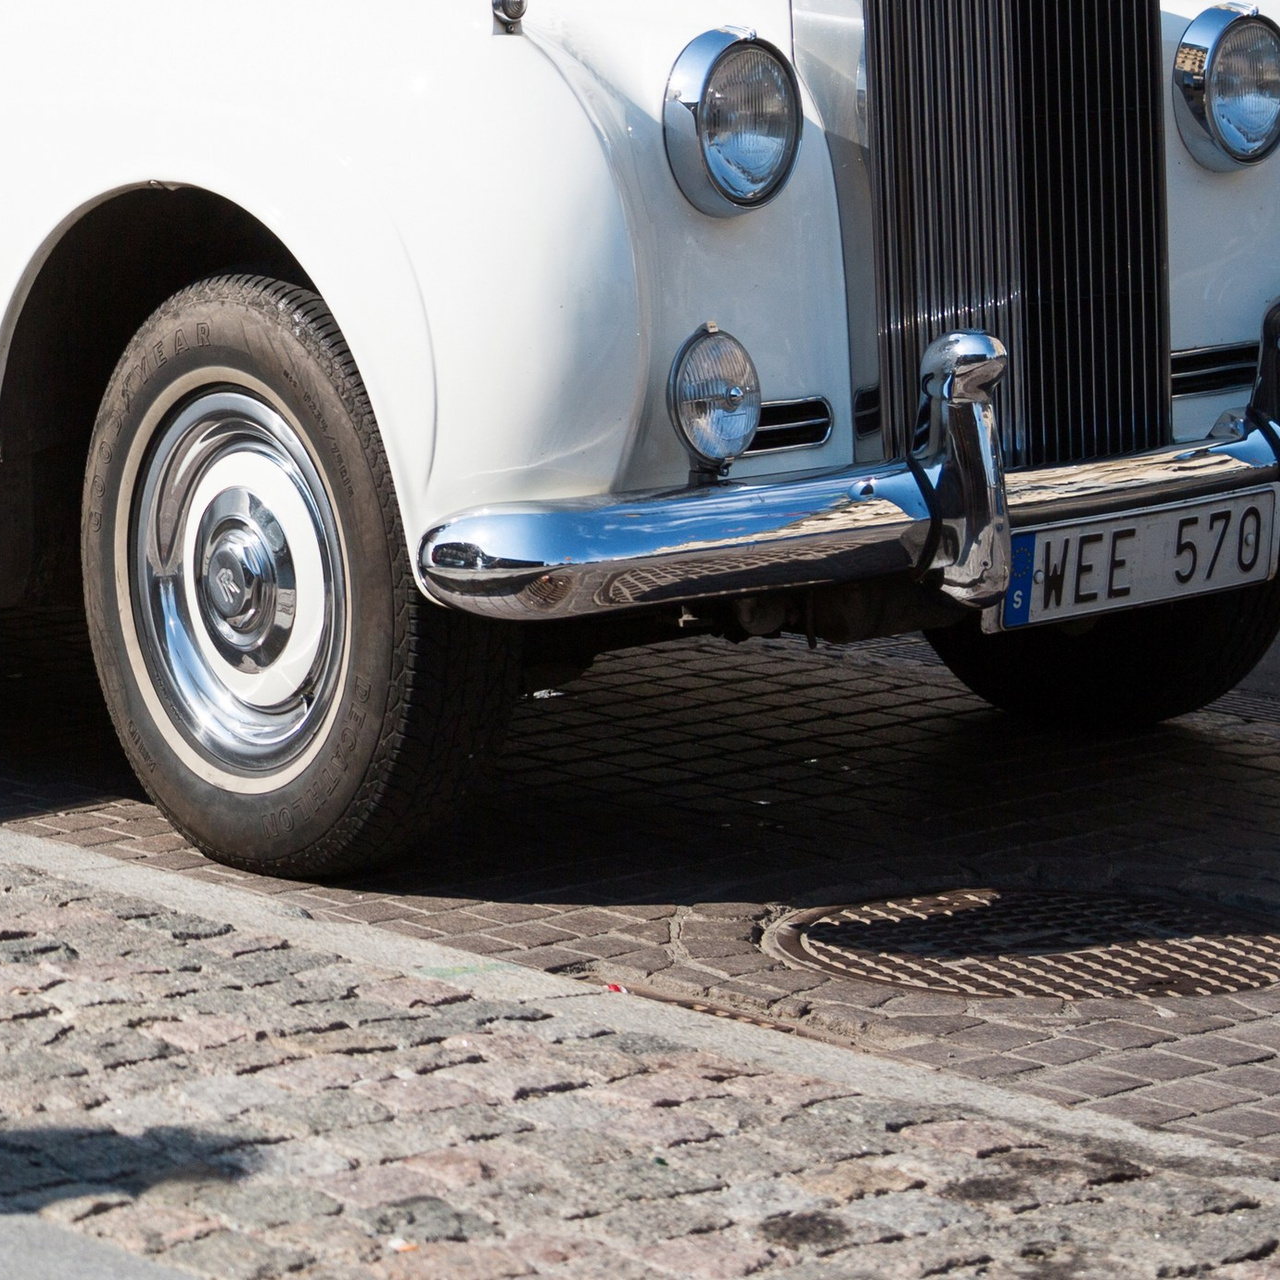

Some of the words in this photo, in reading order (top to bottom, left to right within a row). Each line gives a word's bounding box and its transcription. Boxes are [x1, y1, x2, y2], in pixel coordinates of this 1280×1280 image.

[1013, 590, 1023, 609] S
[1043, 527, 1137, 610] WEE
[1173, 505, 1262, 584] 570
[261, 675, 372, 839] DECATHLON
